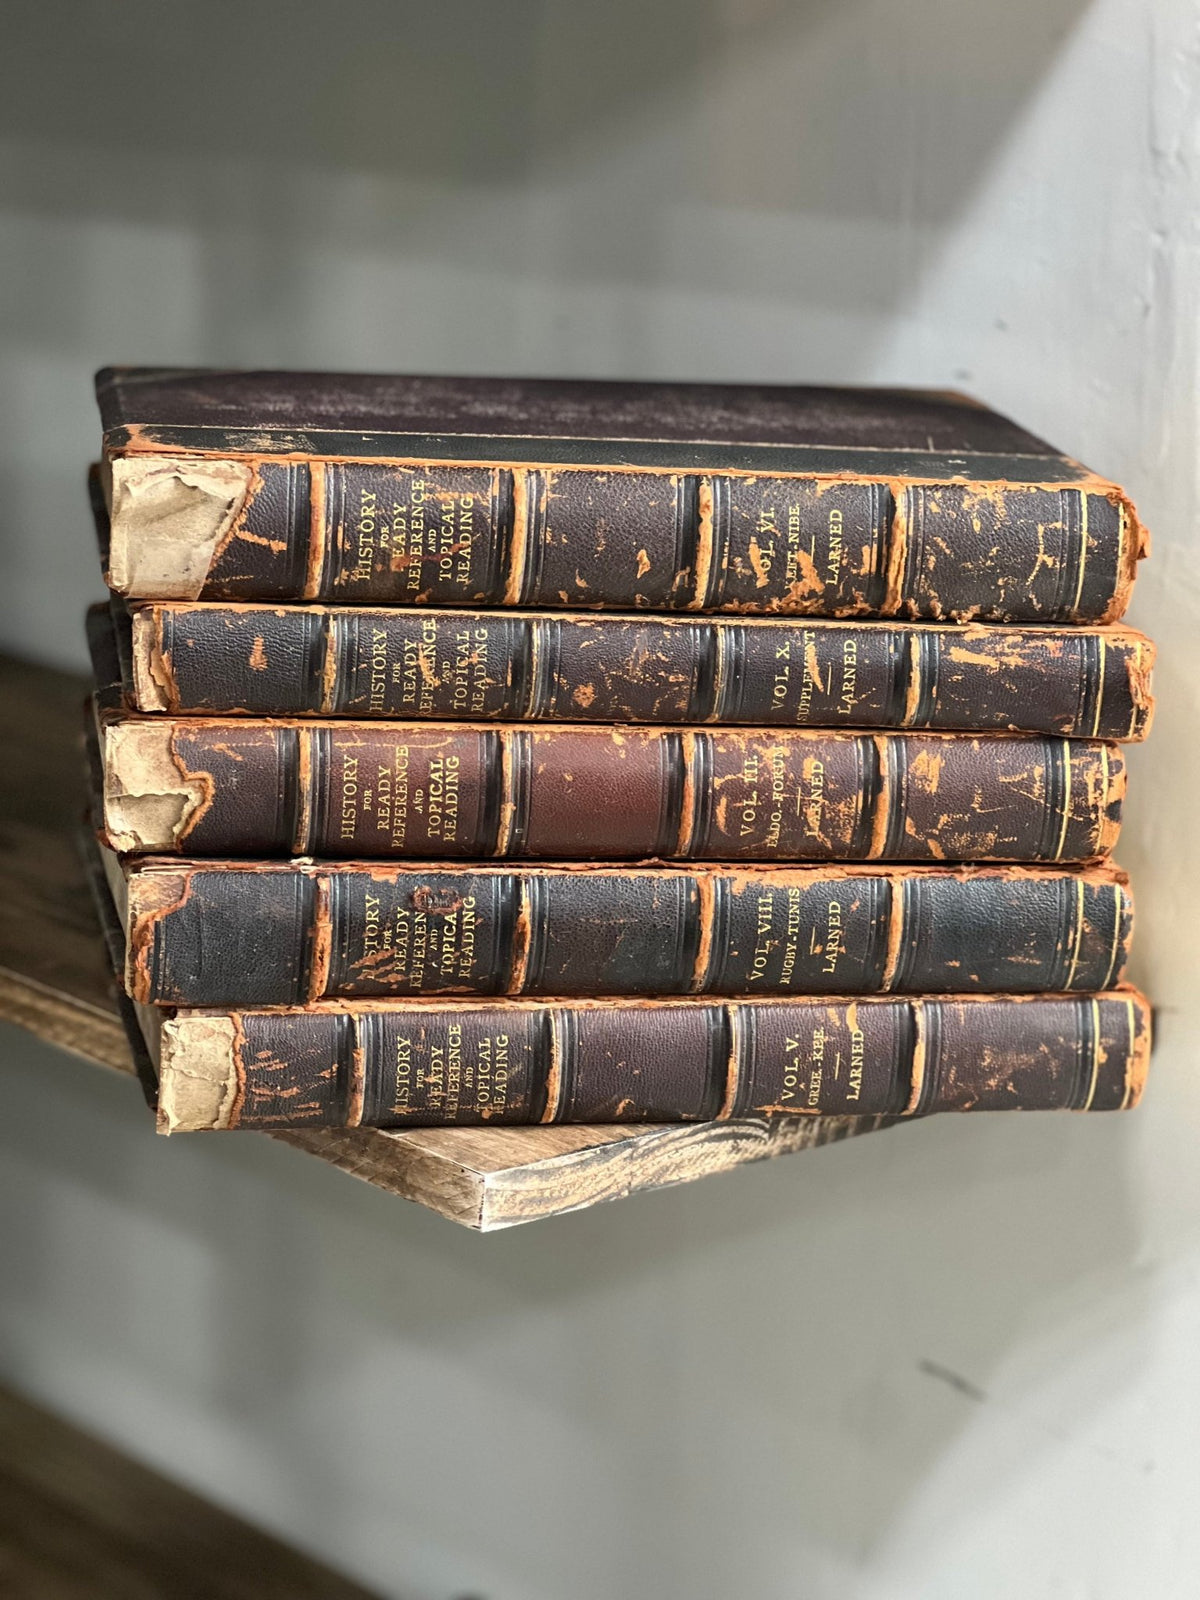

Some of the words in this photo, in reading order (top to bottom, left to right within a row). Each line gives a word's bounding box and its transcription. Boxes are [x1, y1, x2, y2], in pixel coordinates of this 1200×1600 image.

[358, 489, 376, 580] HISTORY
[380, 526, 389, 548] FOR
[393, 503, 406, 572] EADY
[407, 479, 424, 590] REFERENCE
[428, 529, 436, 552] AND
[439, 500, 454, 581] TOPICAL
[456, 497, 473, 583] READING
[826, 509, 842, 585] LARNED
[370, 628, 387, 711] HISTORY
[403, 638, 417, 702] READY
[454, 630, 469, 709] TOPICAL
[471, 628, 487, 711] READING
[797, 630, 815, 721] SUPPLEMNT
[837, 639, 856, 714] LARNED
[341, 755, 358, 838] HISTORY
[364, 790, 372, 810] FOR
[377, 765, 391, 830] READY
[392, 746, 408, 847] REFERENCE
[414, 789, 423, 812] AND
[428, 759, 443, 837] TOPICAL
[444, 756, 459, 841] READING
[384, 930, 392, 949] FOR
[395, 907, 409, 971] READY
[410, 894, 427, 987] REFEREN
[430, 929, 438, 950] AND
[441, 906, 457, 976] TOPICA
[459, 896, 475, 978] READING
[823, 901, 840, 973] LARNED
[429, 1046, 443, 1107] READY
[445, 1024, 461, 1119] REFERENCE
[464, 1067, 473, 1087] AND
[475, 1038, 491, 1112] TOPICAL
[847, 1030, 864, 1100] LARNED
